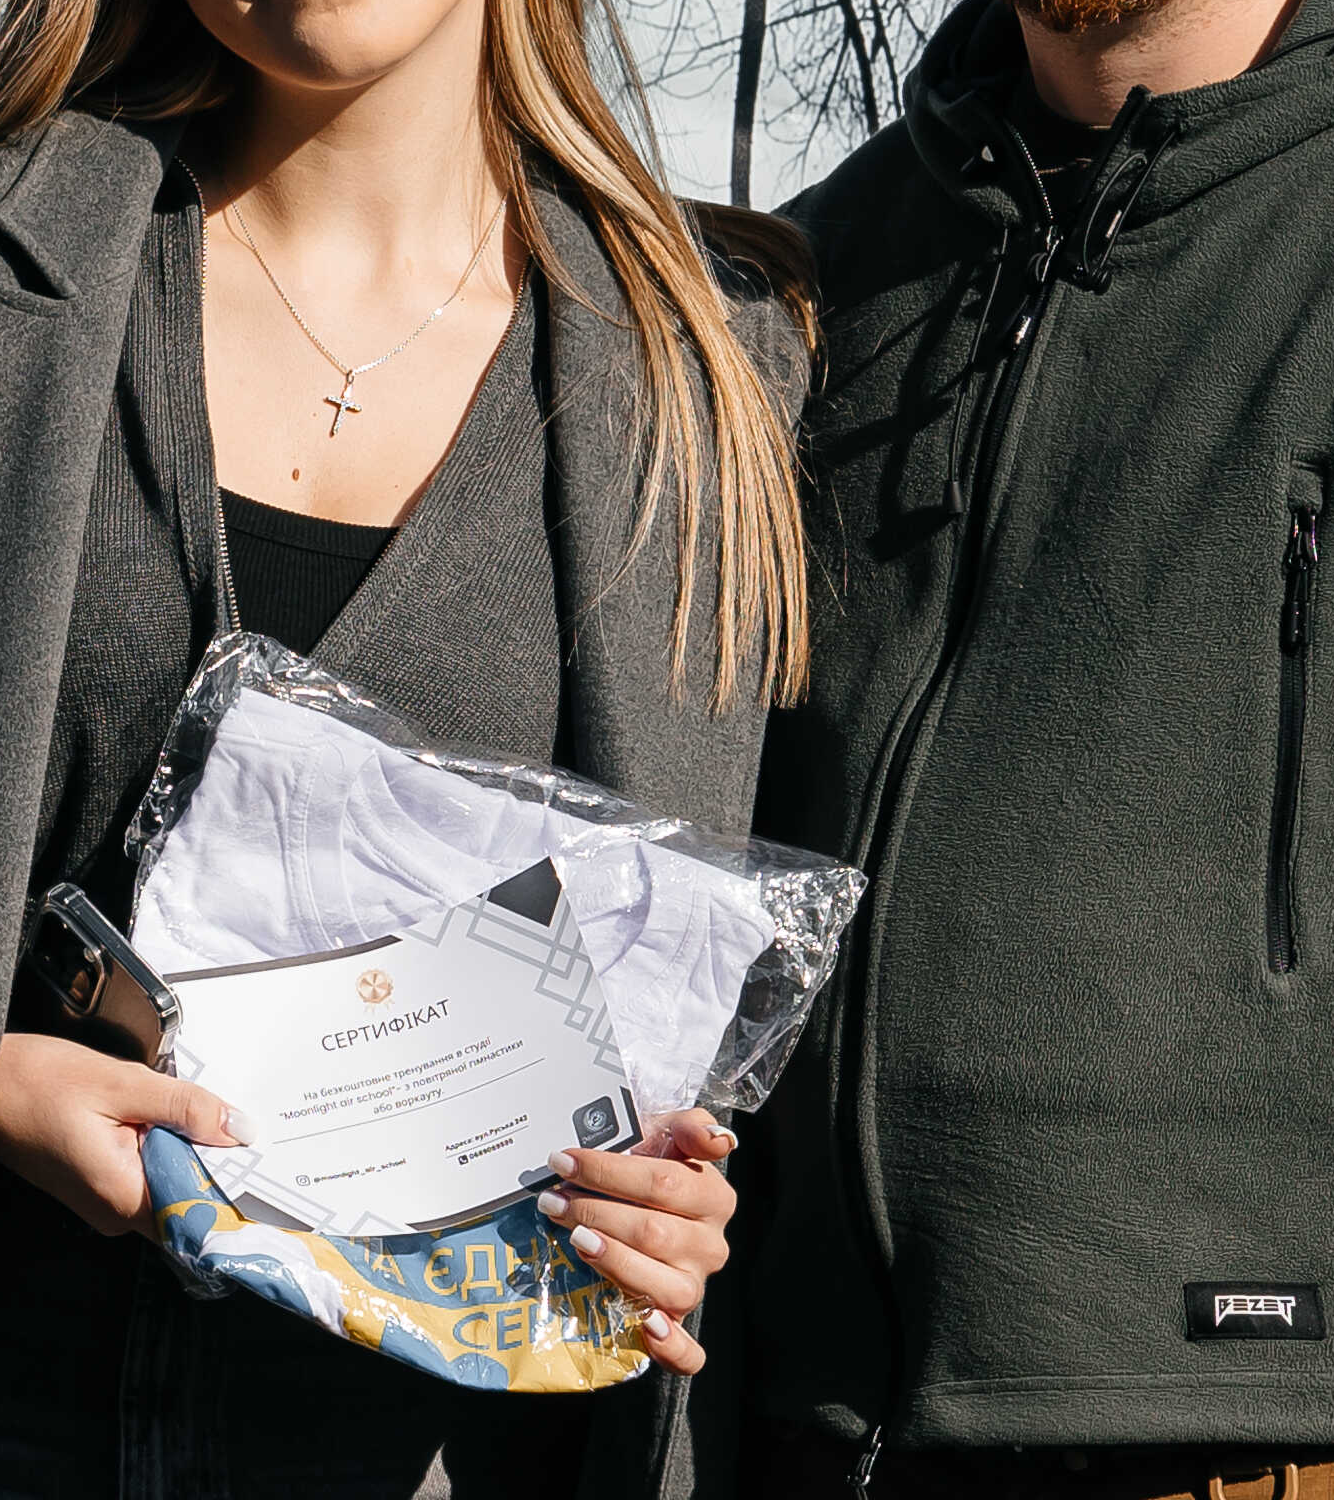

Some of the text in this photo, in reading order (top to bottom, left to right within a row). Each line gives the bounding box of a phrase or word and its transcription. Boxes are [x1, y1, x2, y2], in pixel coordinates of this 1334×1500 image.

[321, 998, 451, 1052] СЕРТИФІКАТ
[303, 1091, 318, 1101] На
[320, 1073, 391, 1097] безкоштовне
[393, 1053, 454, 1079] тренування
[373, 1102, 393, 1115] або
